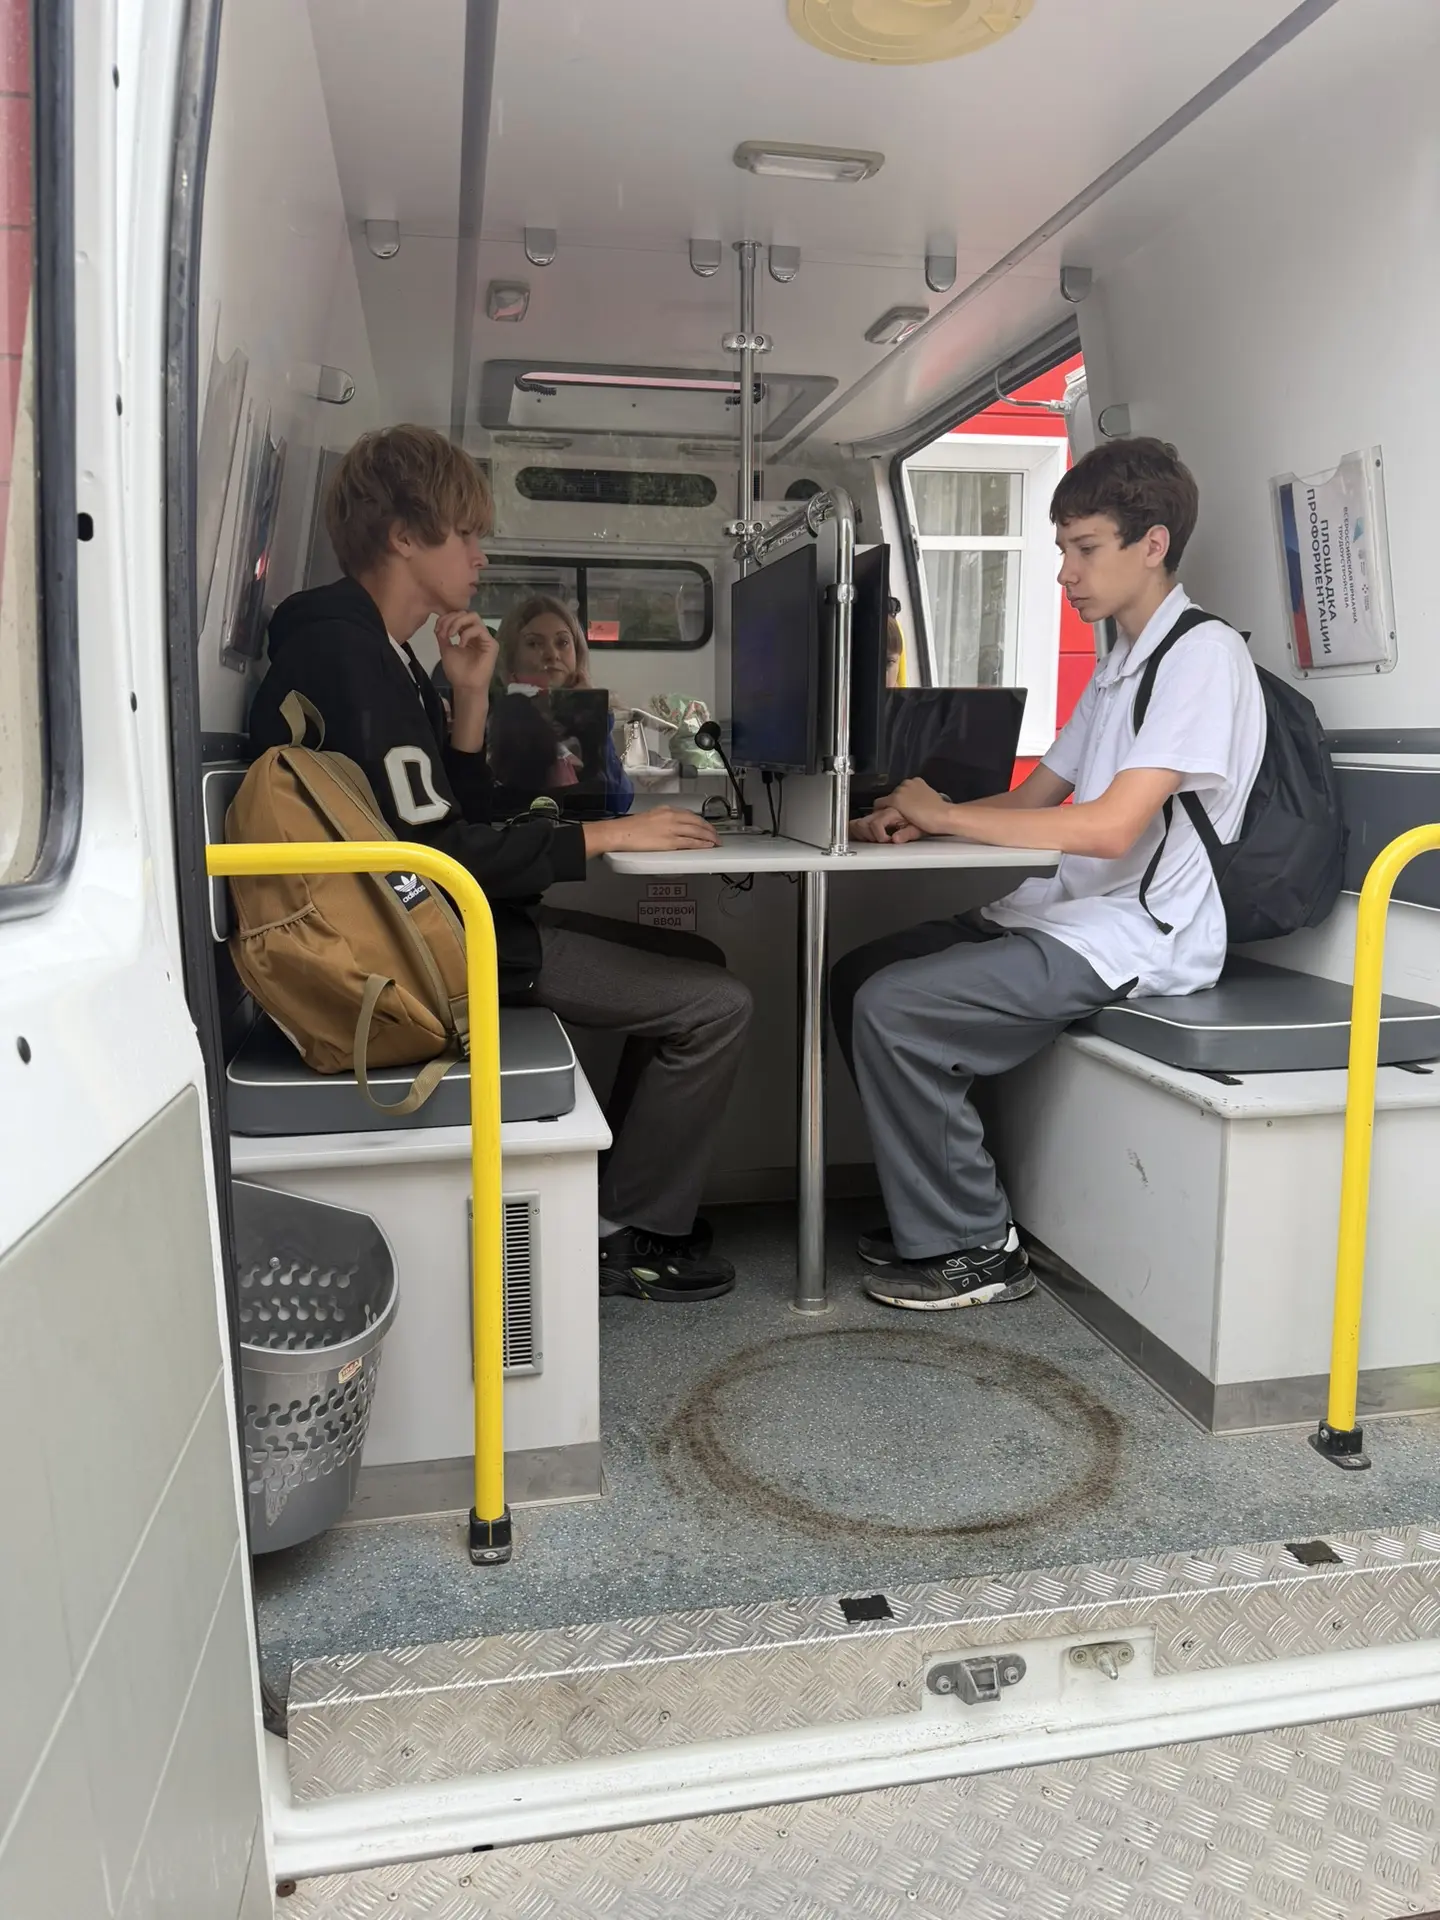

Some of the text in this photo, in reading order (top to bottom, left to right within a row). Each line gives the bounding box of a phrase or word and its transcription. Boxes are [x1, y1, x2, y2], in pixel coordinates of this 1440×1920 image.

[1306, 488, 1332, 654] ПРОФОРИЕНТАЦИИ
[1320, 520, 1337, 621] ПЛОЩАДКА
[1338, 524, 1349, 608] ТРУДОУСТРОЙСТВА
[1343, 506, 1358, 624] ВСЕРОССИЙСКАЯ ЯРМАРКА
[402, 884, 426, 903] adidas
[640, 905, 694, 915] БОРТОВОЙ
[652, 886, 682, 896] 220 В
[653, 917, 682, 927] ВВОД
